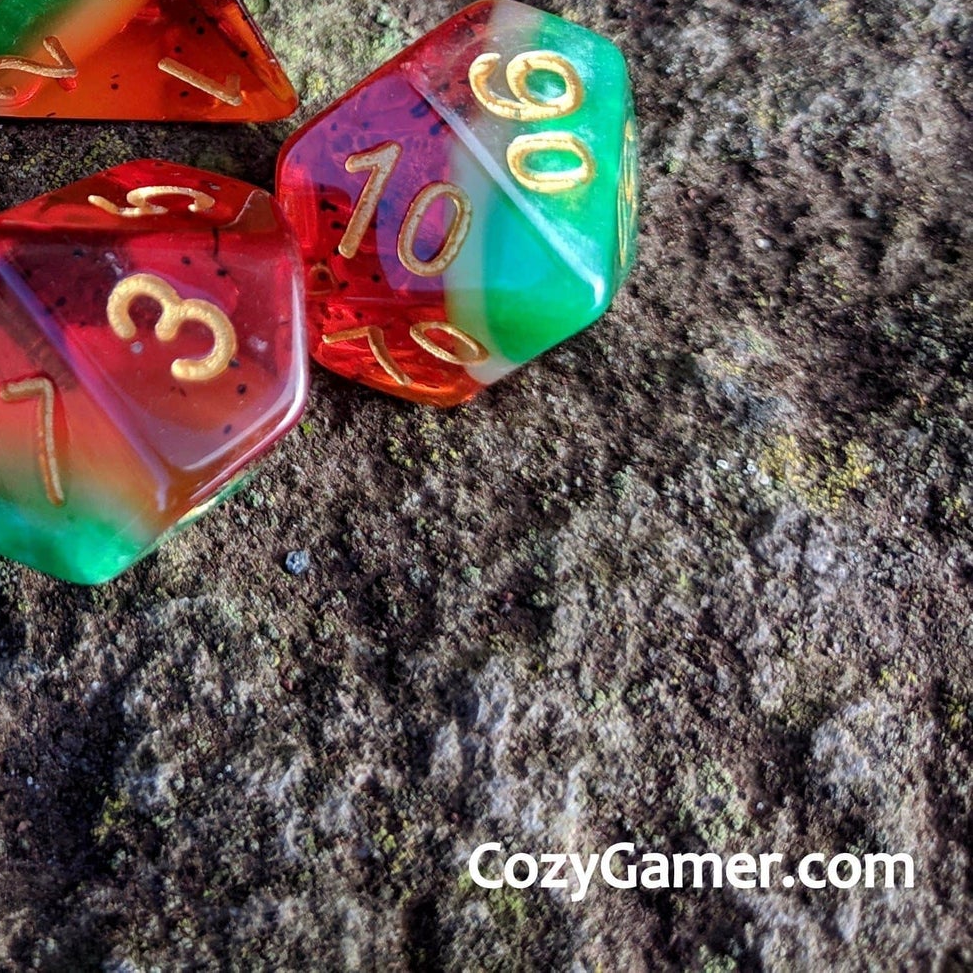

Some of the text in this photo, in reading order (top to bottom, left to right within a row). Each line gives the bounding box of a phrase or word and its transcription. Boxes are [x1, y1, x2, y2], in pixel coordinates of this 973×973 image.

[157, 57, 243, 107] 1
[469, 50, 596, 195] 90
[337, 139, 473, 279] 10
[106, 272, 239, 382] 3
[321, 321, 491, 387] 70
[0, 376, 65, 506] 7
